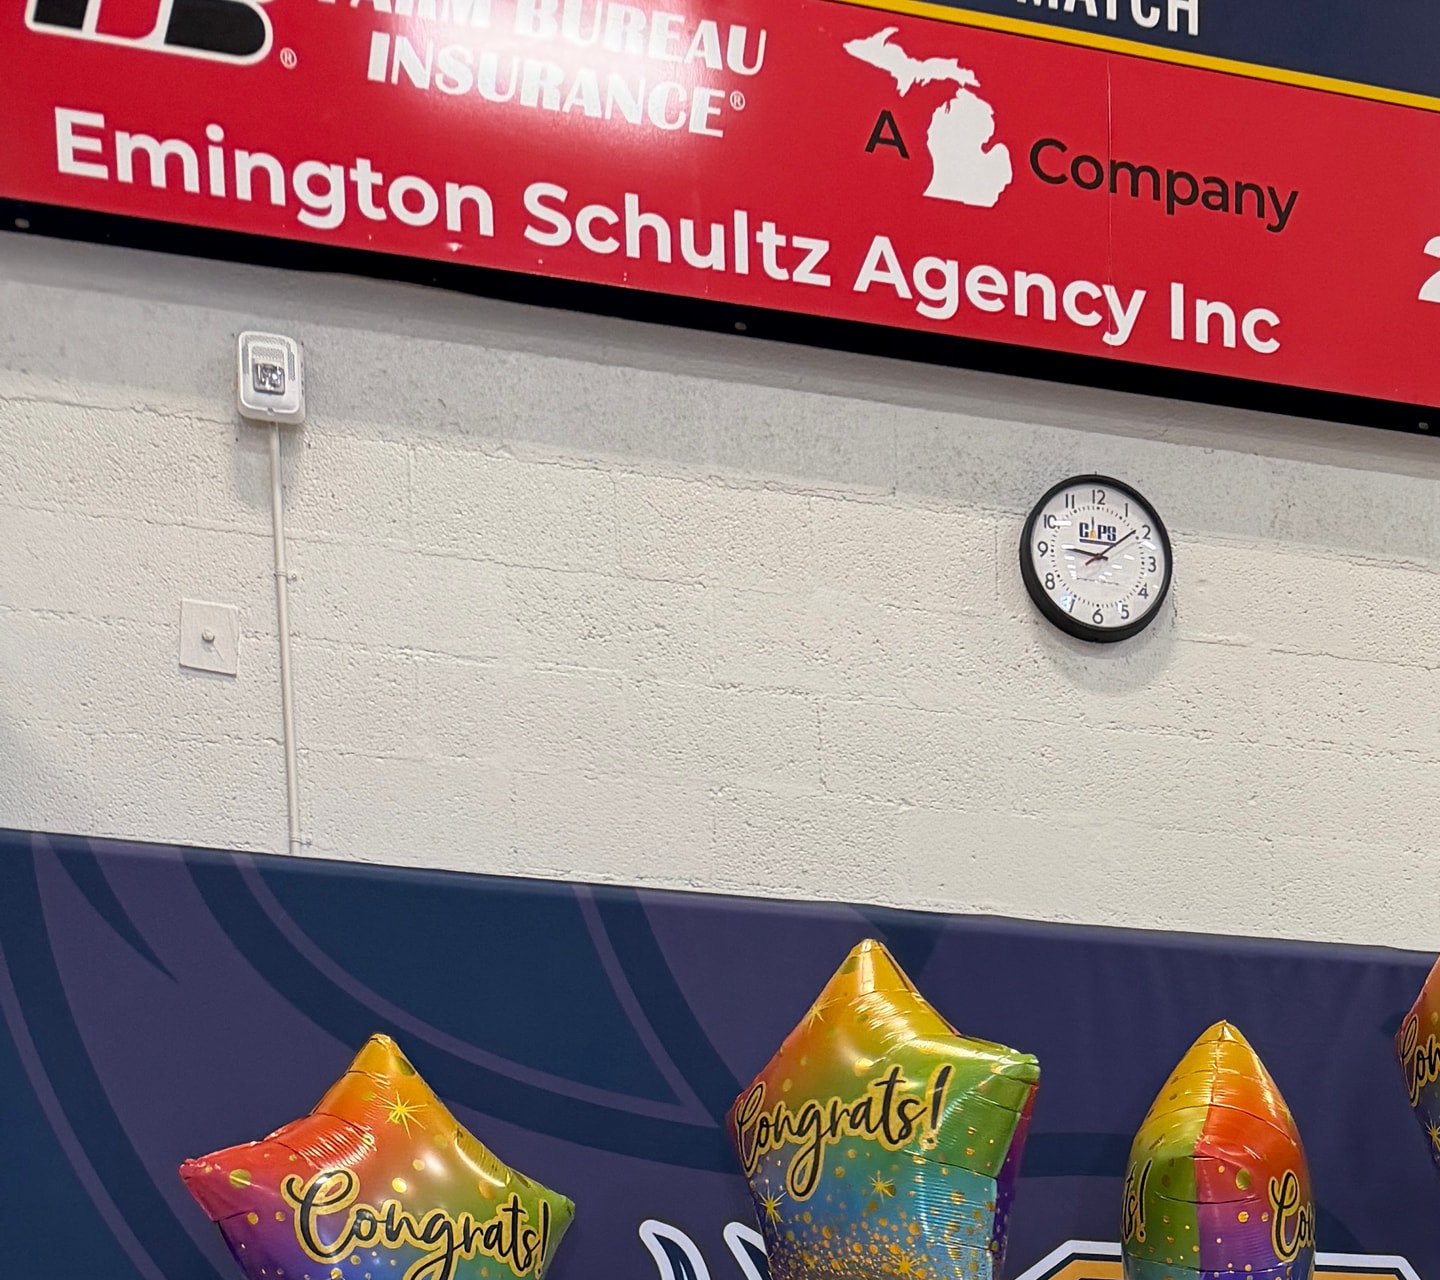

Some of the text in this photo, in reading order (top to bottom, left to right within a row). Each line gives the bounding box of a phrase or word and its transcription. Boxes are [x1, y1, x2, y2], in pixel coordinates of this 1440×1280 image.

[513, 0, 767, 76] BUREAU
[864, 110, 1299, 233] A Company
[54, 106, 1281, 355] Emington Schultz Agency Inc
[1065, 493, 1075, 509] 11
[1092, 489, 1106, 505] 12
[1043, 514, 1057, 529] 10
[1142, 525, 1151, 540] 2
[1037, 541, 1048, 557] 9
[1148, 556, 1157, 573] 3
[1045, 573, 1055, 590] 8
[1137, 583, 1149, 599] 4
[1092, 608, 1104, 624] 6
[1121, 605, 1130, 619] 5
[736, 1064, 953, 1200] Congrats!
